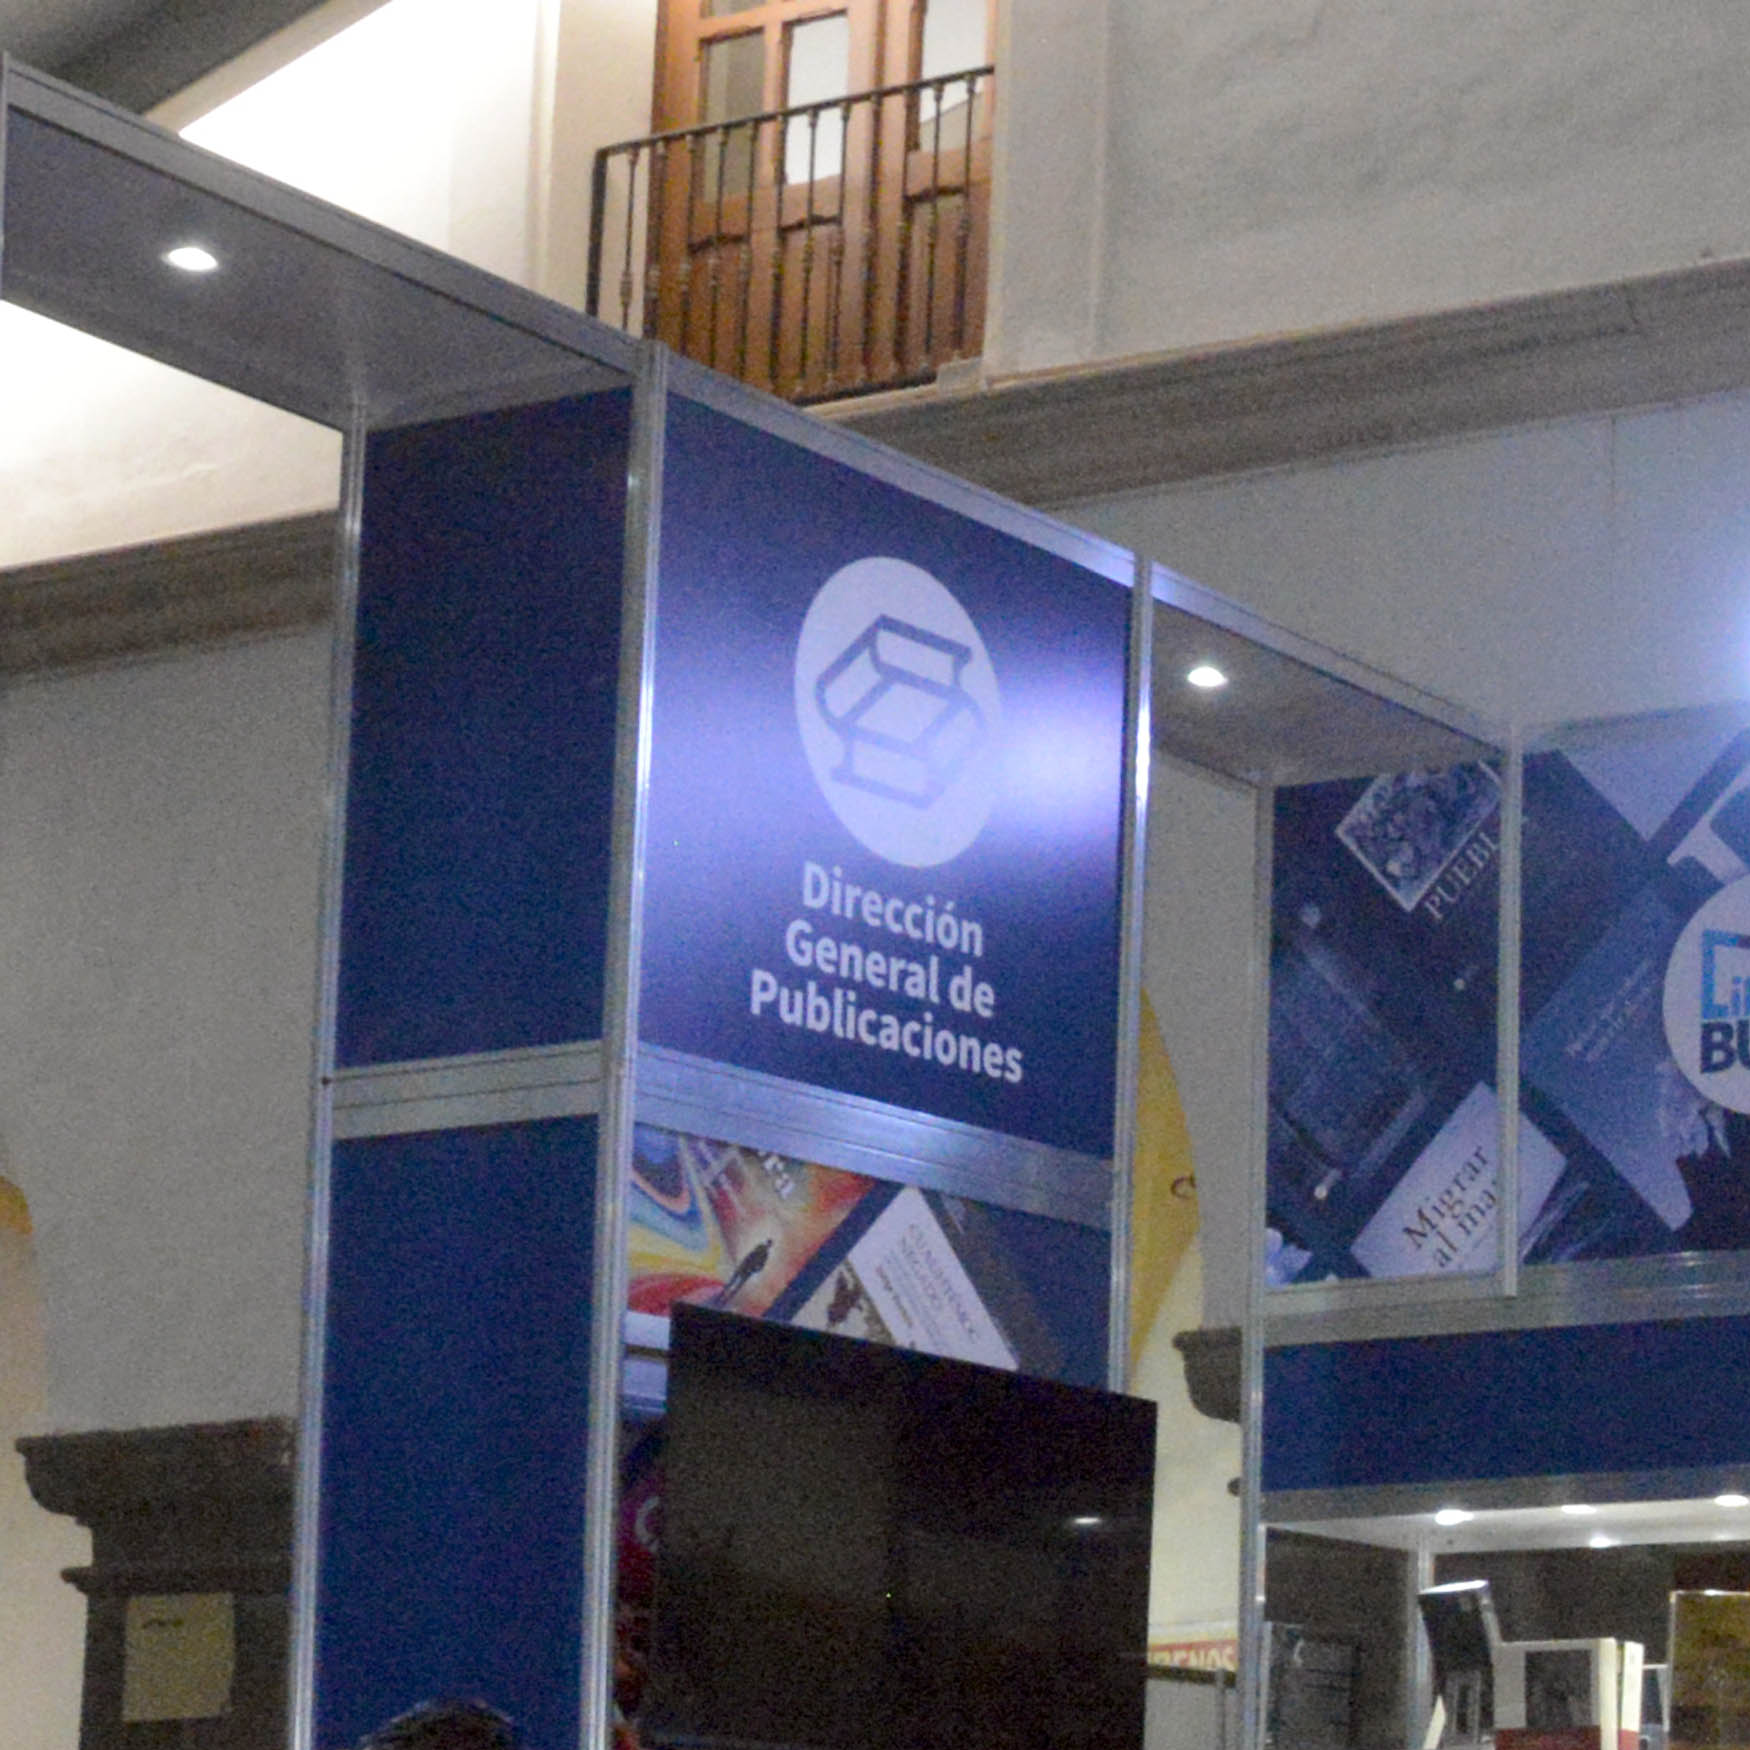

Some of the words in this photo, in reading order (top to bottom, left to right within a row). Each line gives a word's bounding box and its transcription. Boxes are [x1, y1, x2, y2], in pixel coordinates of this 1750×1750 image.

[802, 861, 984, 958] Dirección
[1423, 832, 1500, 920] PUEBL
[785, 918, 940, 1005] General
[949, 967, 995, 1019] de
[750, 968, 1025, 1084] Publicaciones
[1402, 1146, 1488, 1249] Migrar
[1434, 1230, 1459, 1268] al
[1457, 1179, 1498, 1236] ma
